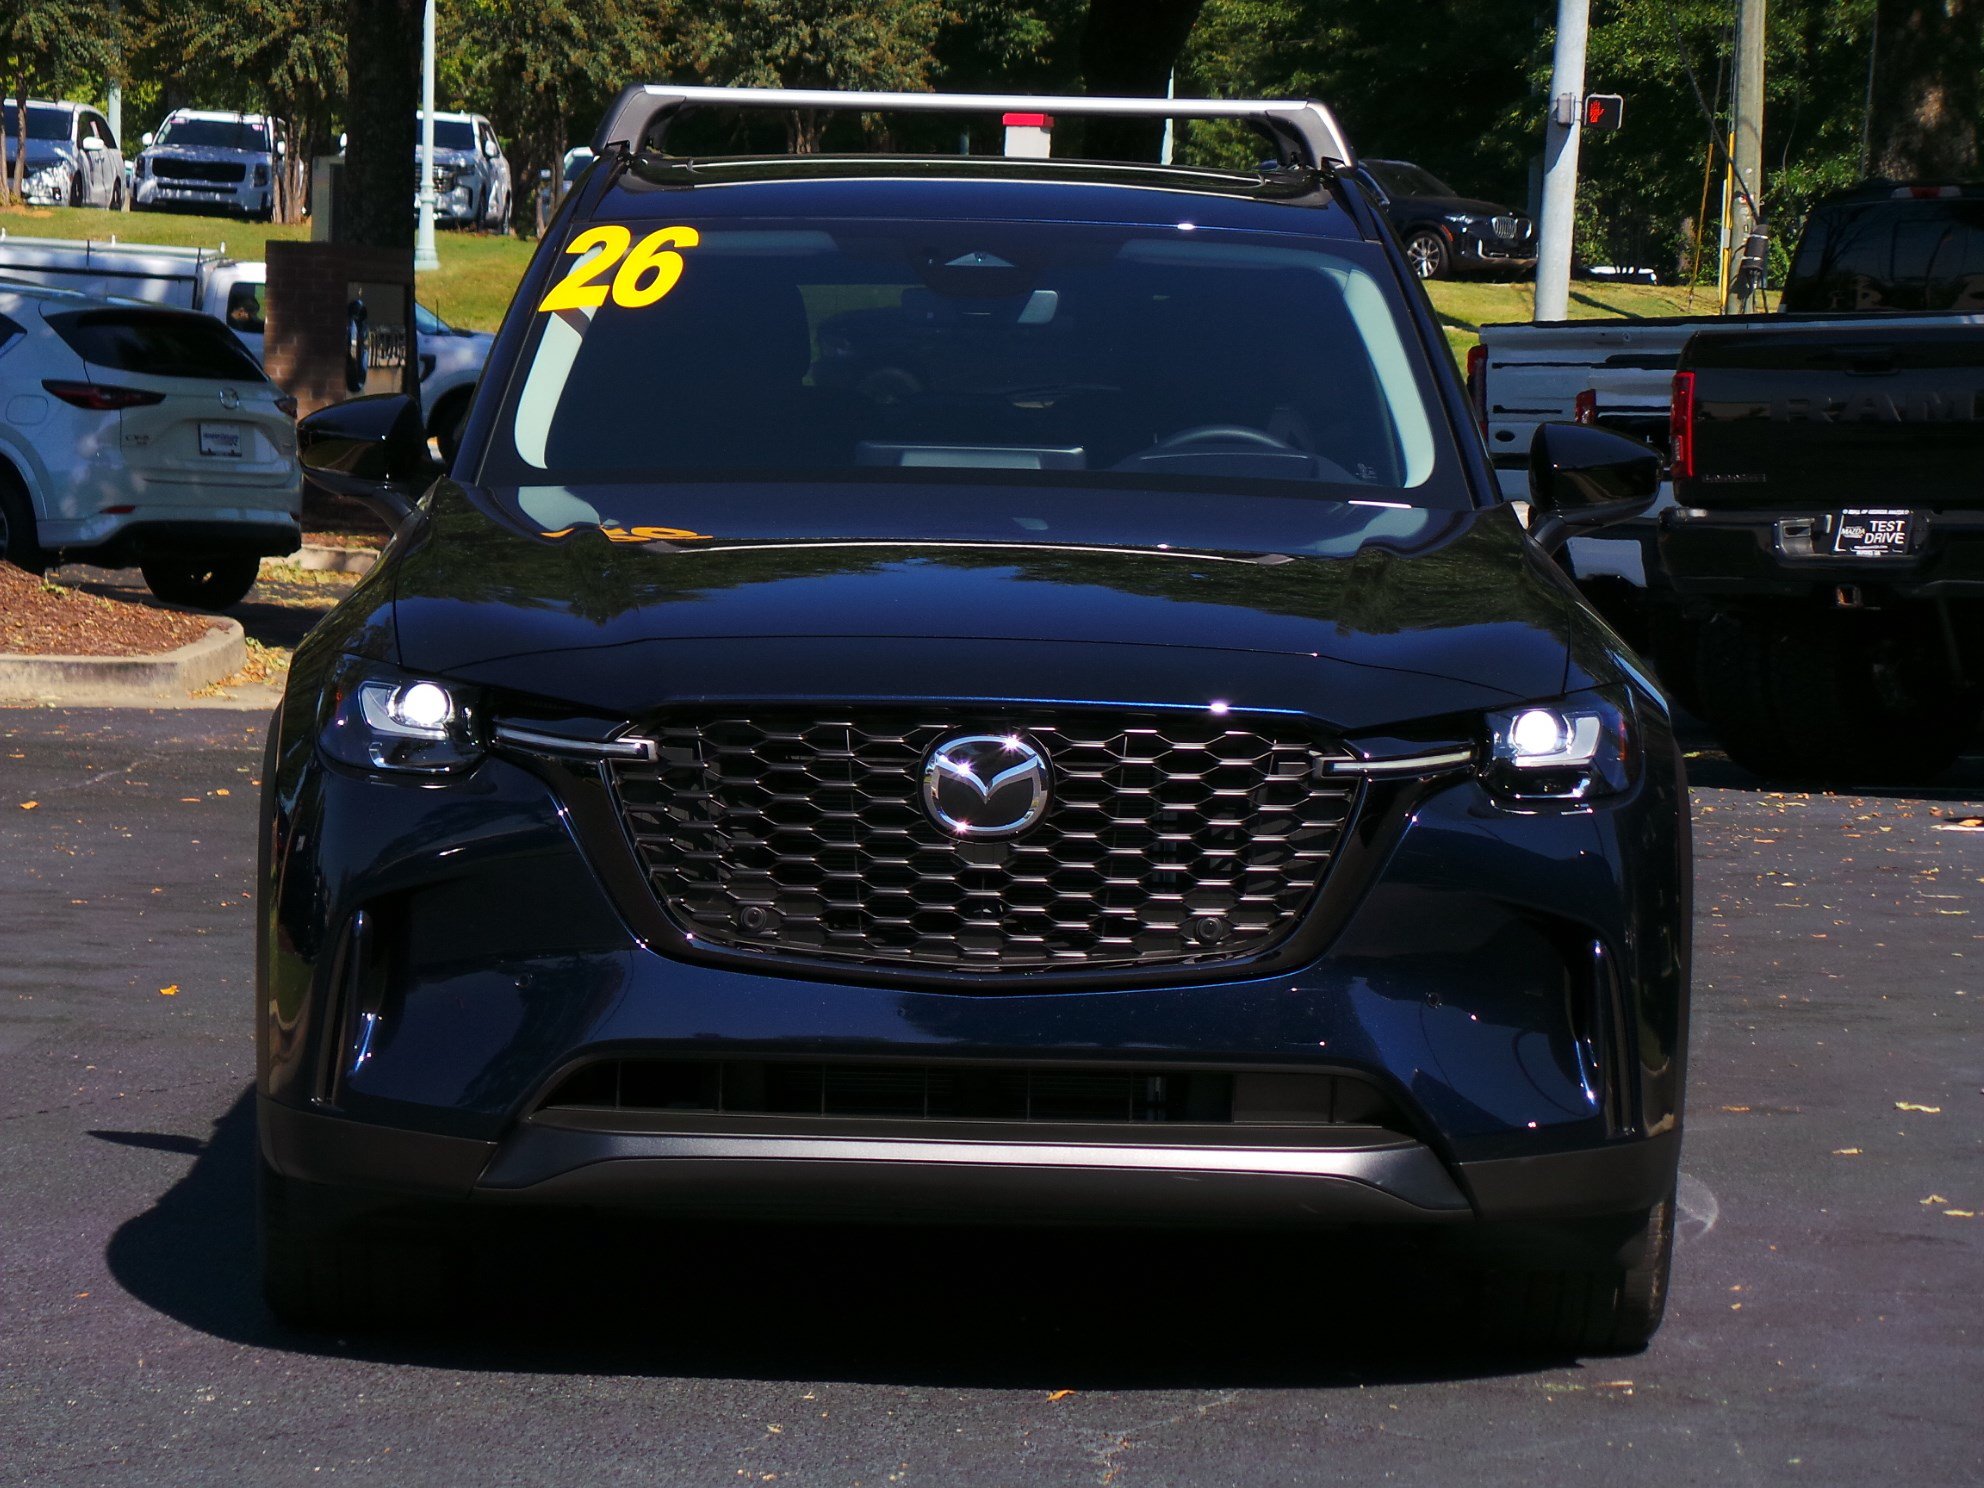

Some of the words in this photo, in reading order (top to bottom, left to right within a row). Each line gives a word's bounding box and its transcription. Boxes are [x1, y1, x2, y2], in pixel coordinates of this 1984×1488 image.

[538, 225, 699, 312] 26
[1773, 391, 1975, 423] RAM
[1870, 520, 1905, 532] TEST
[1864, 532, 1906, 544] DRIVE
